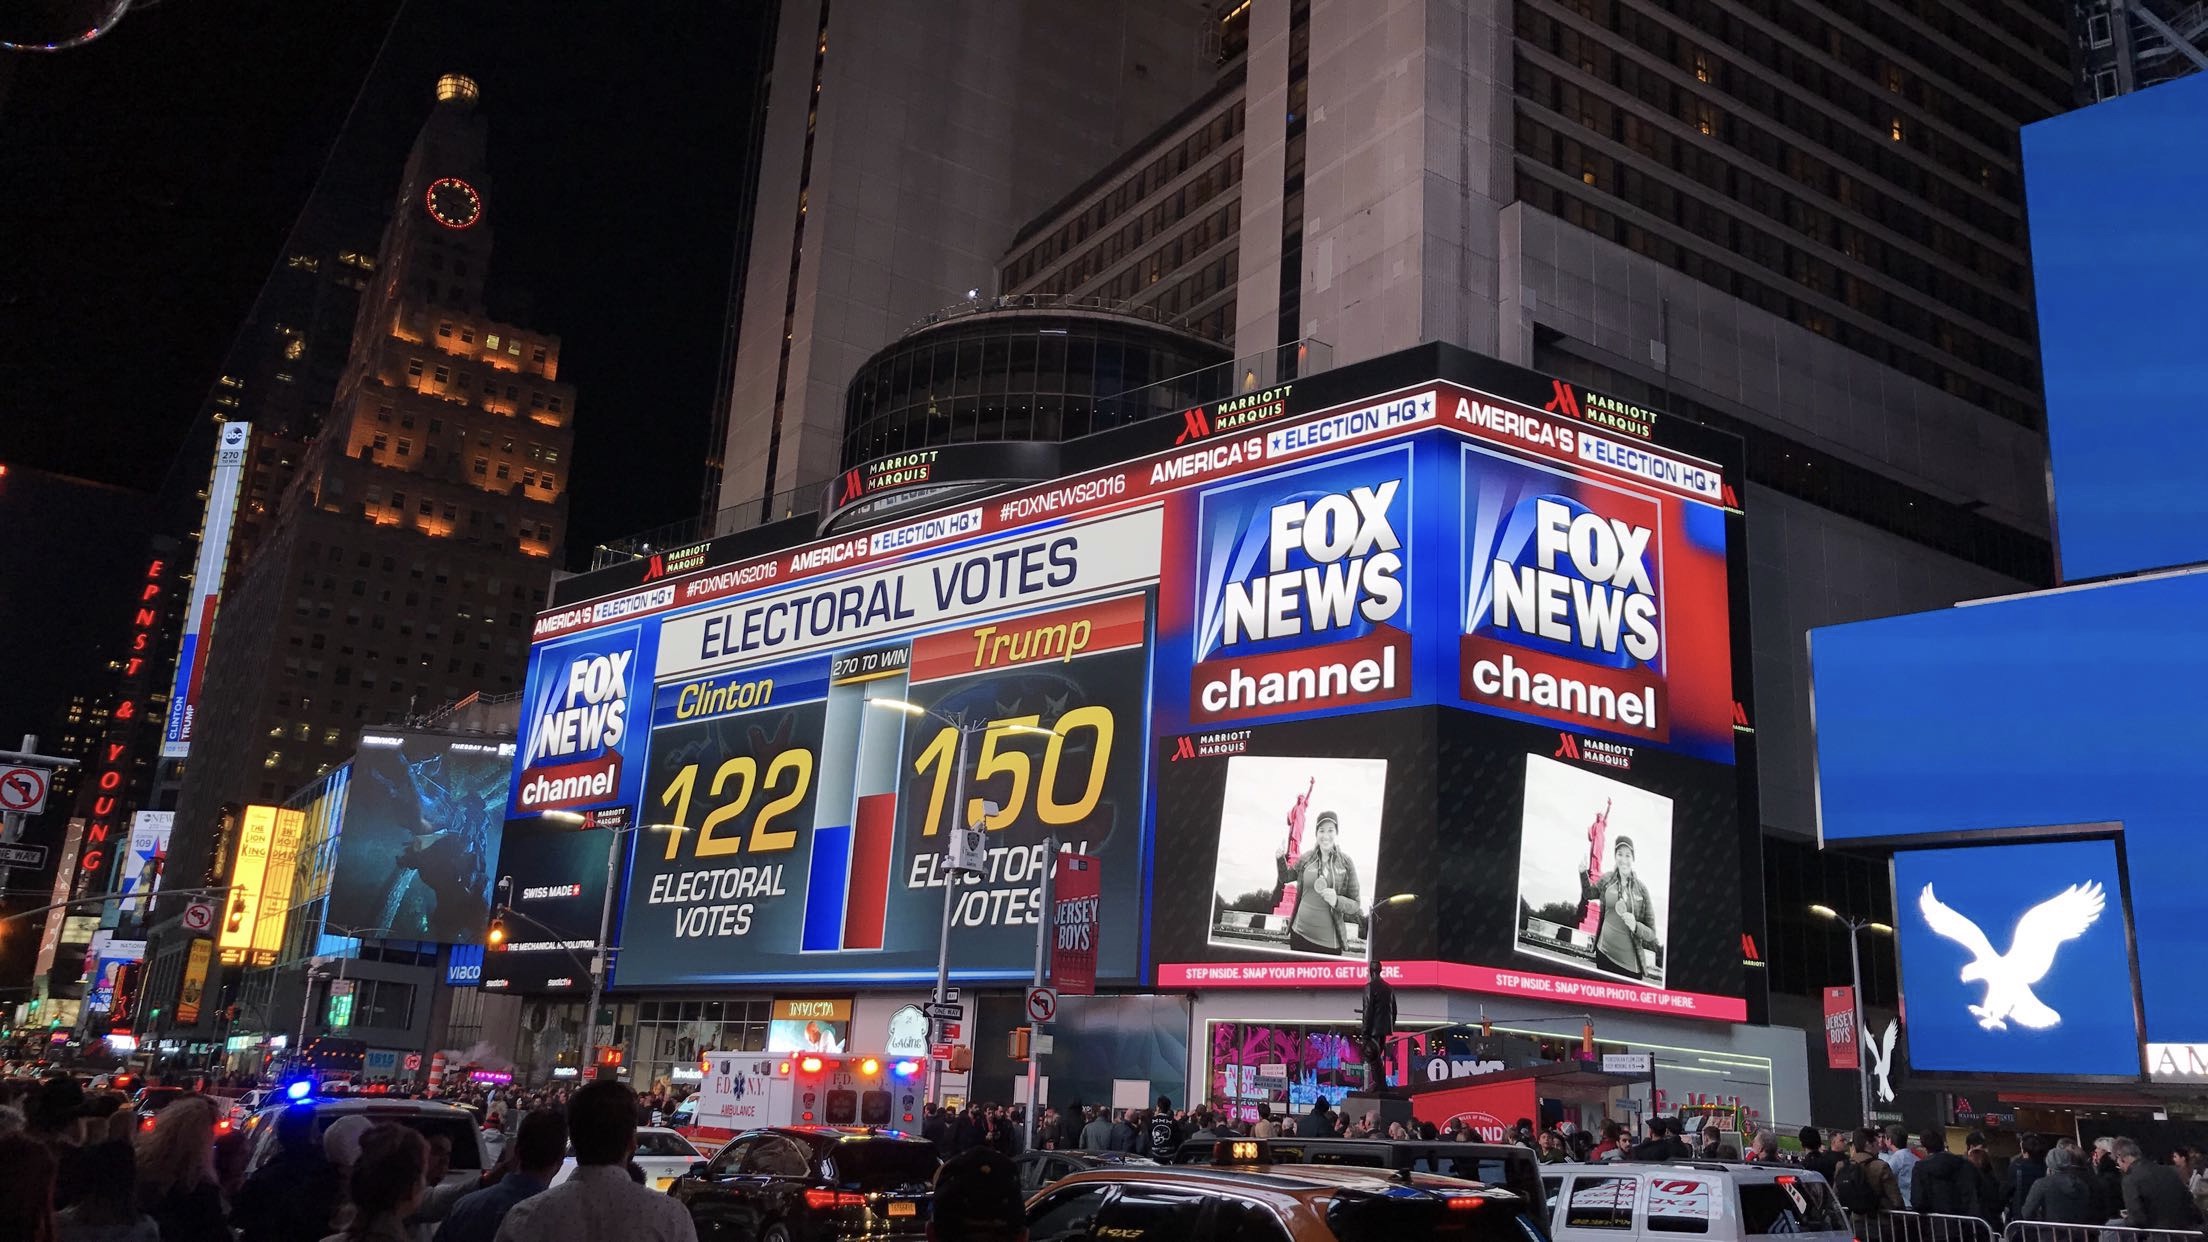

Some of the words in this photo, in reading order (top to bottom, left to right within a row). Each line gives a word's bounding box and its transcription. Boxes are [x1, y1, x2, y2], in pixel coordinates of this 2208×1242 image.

[1217, 402, 1282, 429] MARQUIS
[1218, 386, 1292, 414] MARRIOTT
[1587, 392, 1657, 424] MARRIOTT
[1588, 408, 1650, 436] MARQUIS
[1150, 437, 1262, 486] AMERICA'S
[1285, 408, 1379, 450] ELECTION
[1387, 399, 1416, 424] HQ
[1455, 397, 1574, 453] AMERICA'S
[1596, 440, 1677, 482] ELECTION
[1683, 469, 1706, 491] HQ
[868, 467, 928, 489] MARQUIS
[869, 451, 939, 475] MARRIOTT
[1000, 474, 1126, 522] #FOXNEWS2016
[1269, 479, 1402, 573] FOX
[668, 543, 711, 561] MARRIOTT
[789, 537, 867, 574] AMERICA'S
[882, 516, 945, 550] ELECTION
[949, 513, 969, 535] HQ
[1537, 497, 1656, 597] FOX
[667, 556, 705, 572] MARQUIS
[686, 560, 778, 598] #FOXNEWS2016
[534, 606, 593, 636] AMERICA'S
[601, 594, 648, 618] ELECTION
[650, 589, 666, 606] HQ
[701, 575, 914, 661] ELECTORAL
[933, 536, 1078, 612] VOTES
[1224, 552, 1403, 646] NEWS
[1493, 558, 1659, 660] NEWS
[973, 619, 1092, 667] Trump
[833, 656, 857, 676] 270
[861, 653, 877, 671] TO
[880, 647, 908, 667] WIN
[566, 650, 633, 710] FOX
[1201, 645, 1395, 712] channel
[1472, 654, 1656, 729] channel
[676, 678, 773, 721] Clinton
[169, 696, 184, 740] CLINTON
[181, 704, 195, 740] TRUMP
[538, 699, 626, 759] NEWS
[1200, 742, 1244, 755] MARQUIS
[1201, 730, 1251, 744] MARRIOTT
[1584, 739, 1634, 757] MARRIOTT
[914, 705, 1114, 836] 150
[1584, 750, 1629, 767] MARQUIS
[522, 764, 616, 806] channel
[82, 743, 125, 870] YOUNG
[598, 808, 625, 817] MARRIOTT
[662, 748, 813, 861] 122
[241, 844, 266, 857] KING
[246, 832, 265, 843] LION
[15, 851, 38, 861] WAY
[523, 887, 548, 899] SWISS
[549, 885, 573, 897] MADE
[649, 863, 786, 904] ELECTORAL
[675, 903, 754, 938] VOTES
[1054, 898, 1099, 925] JERSEY
[508, 943, 519, 951] THE
[519, 942, 555, 951] MECHANICAL
[1058, 923, 1090, 951] BOYS
[1186, 968, 1208, 979] STEP
[1209, 968, 1241, 979] INSIDE.
[1243, 968, 1267, 979] SNAP
[1268, 968, 1295, 979] YOUR
[1297, 968, 1333, 979] PHOTO.
[1335, 968, 1355, 979] GET
[1496, 975, 1519, 987] STEP
[1521, 979, 1553, 991] INSIDE.
[1555, 983, 1579, 994] SNAP
[1580, 985, 1604, 997] YOUR
[1606, 987, 1639, 1001] PHOTO.
[1640, 993, 1657, 1004] GET
[1659, 995, 1670, 1006] UP
[1671, 996, 1696, 1009] HERE.
[789, 1001, 834, 1017] INVICTA
[1825, 1010, 1854, 1030] JERSEY
[1830, 1028, 1851, 1044] BOYS
[716, 1076, 732, 1094] F.D.
[747, 1077, 764, 1096] N.Y.
[721, 1104, 755, 1117] AMBULANCE
